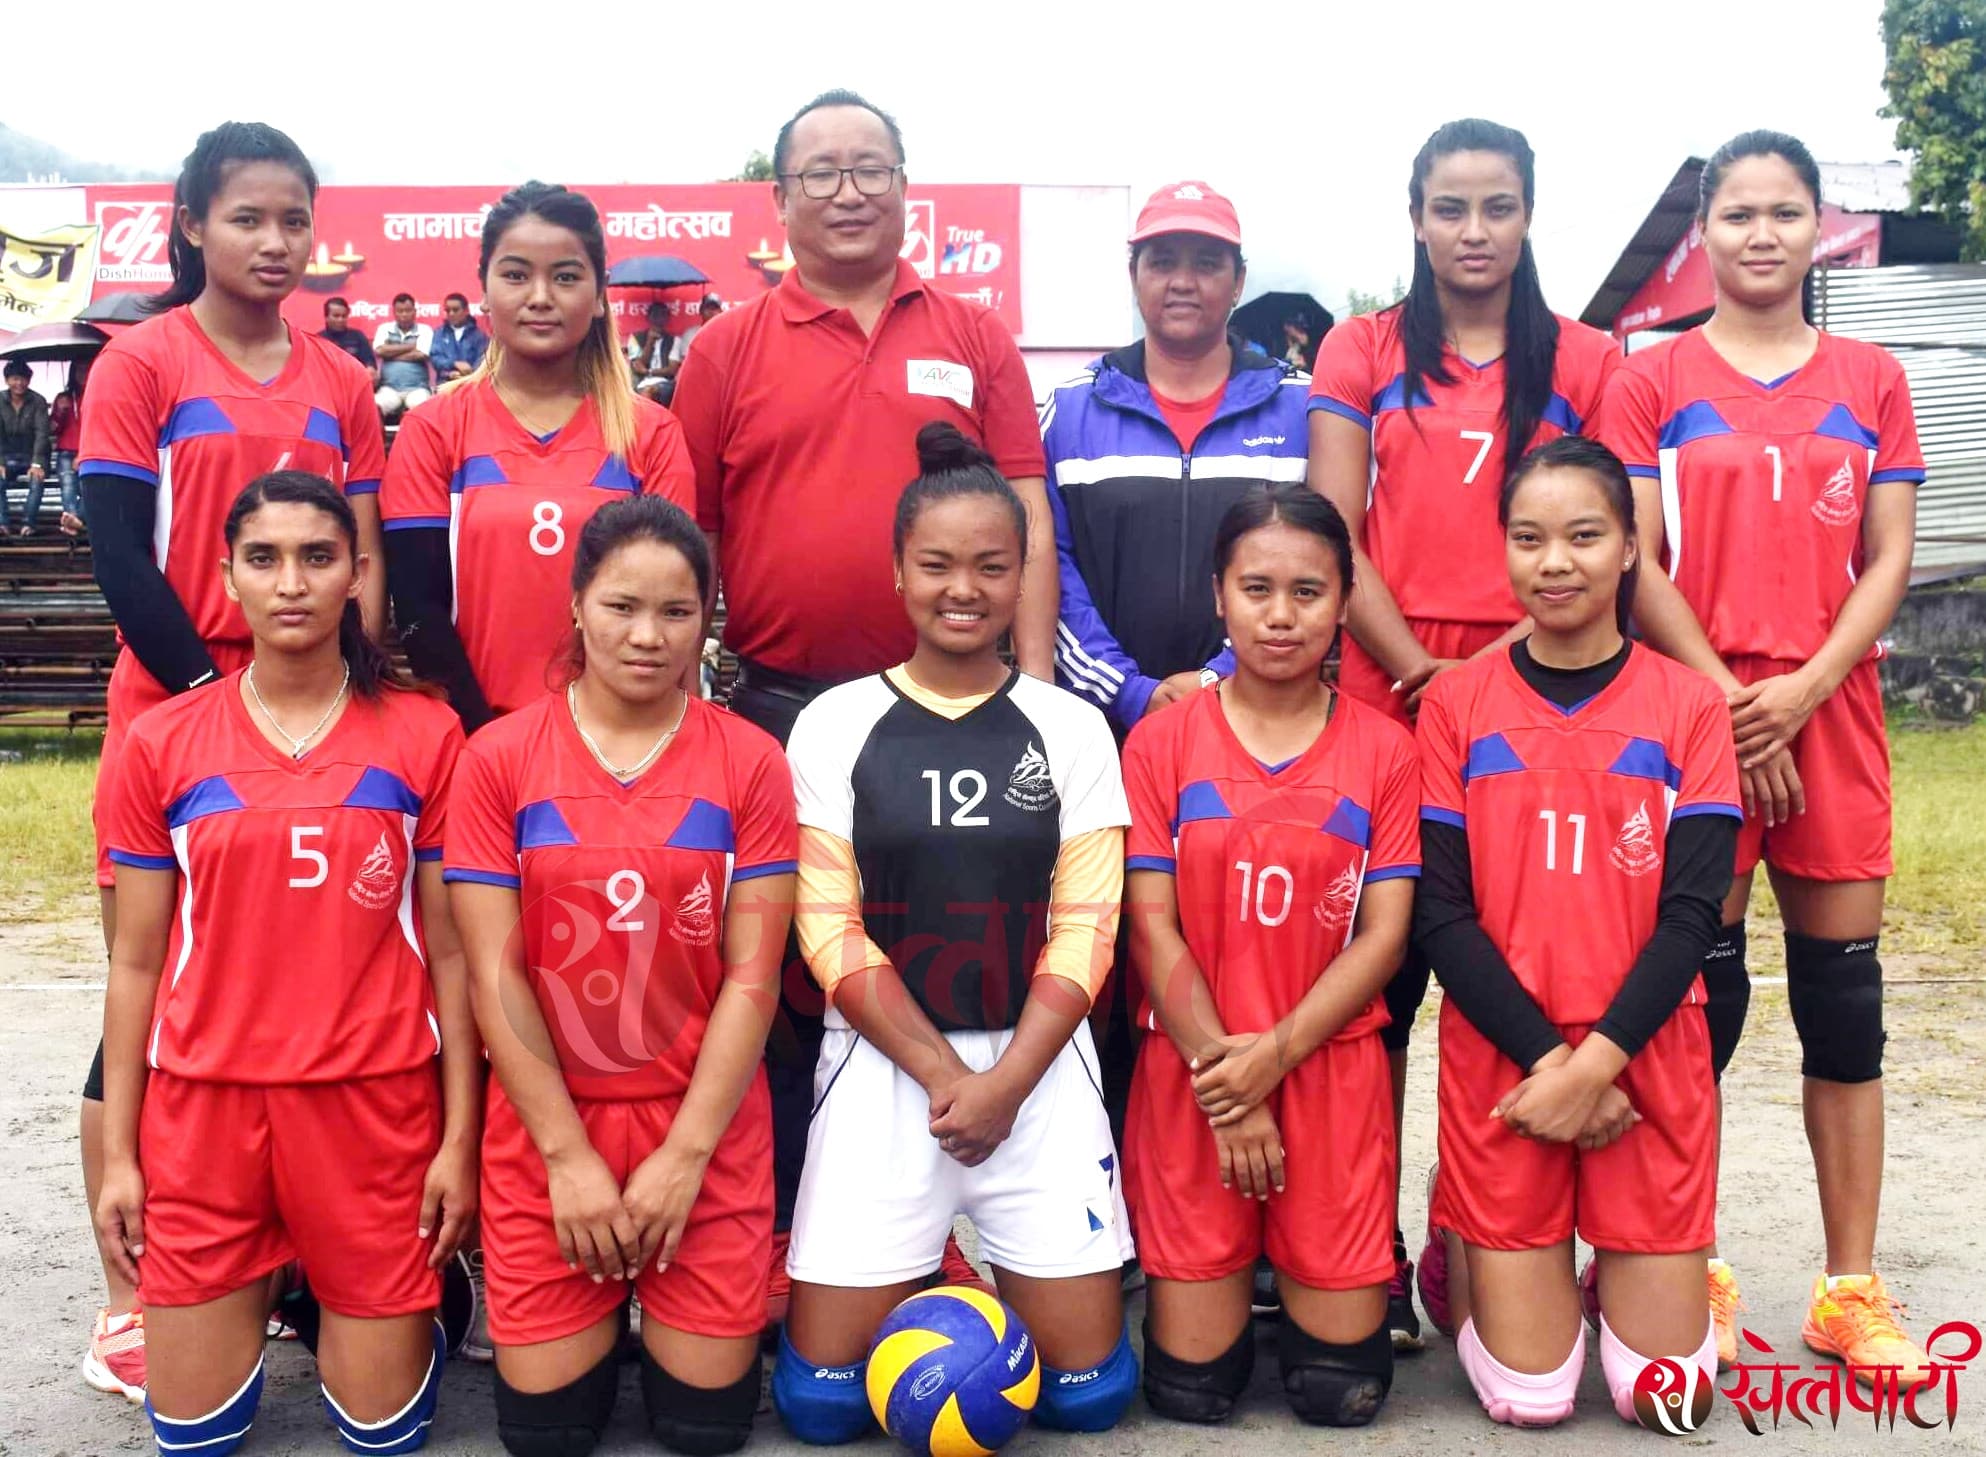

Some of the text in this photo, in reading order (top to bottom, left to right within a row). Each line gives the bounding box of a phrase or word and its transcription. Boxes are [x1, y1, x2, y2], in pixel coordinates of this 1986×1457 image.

[606, 203, 733, 241] महोत्सव
[947, 226, 985, 242] True
[940, 242, 1002, 274] HD
[1460, 430, 1494, 484] 7
[1765, 446, 1782, 501] 1
[529, 501, 565, 555] 8
[921, 769, 989, 827] 12
[289, 827, 328, 888] 5
[1539, 810, 1586, 875] 11
[606, 869, 645, 931] 2
[1235, 861, 1294, 927] 10
[827, 1370, 856, 1380] asics
[1072, 1369, 1099, 1383] asics
